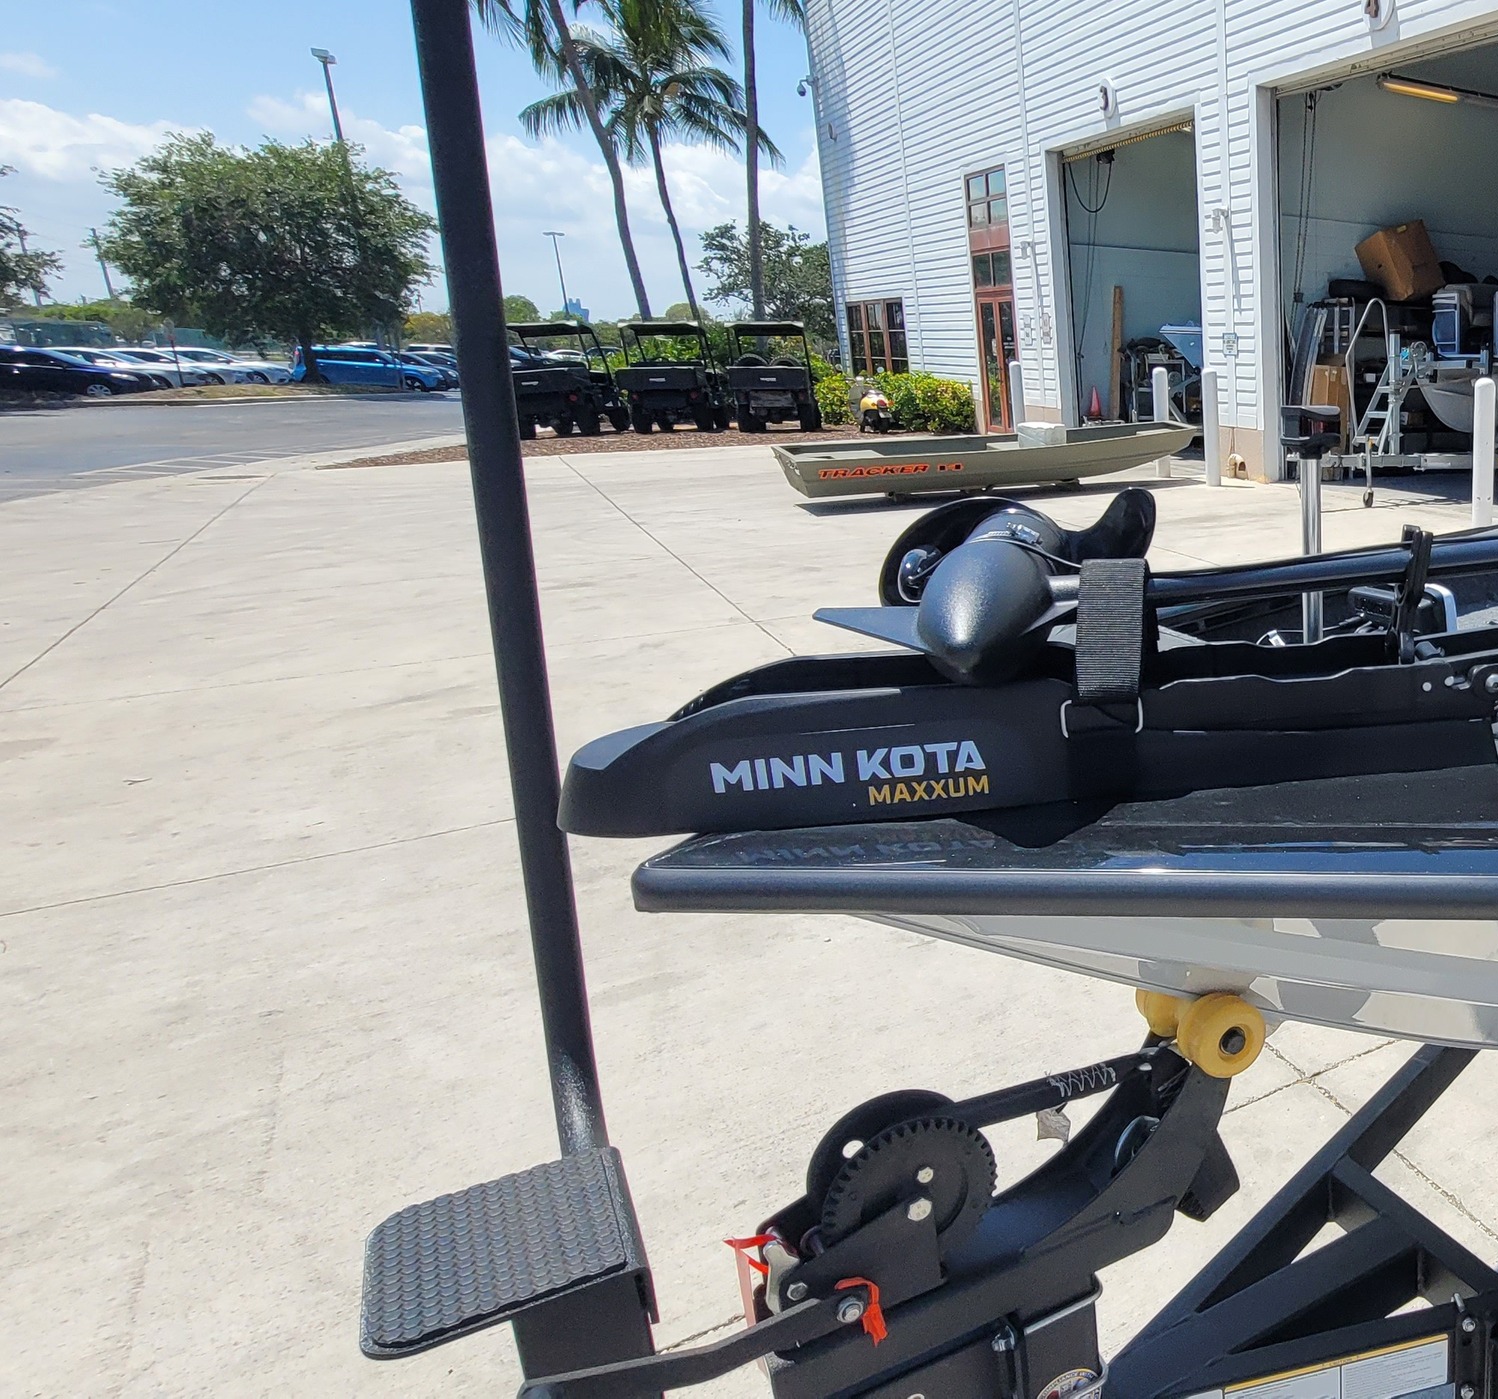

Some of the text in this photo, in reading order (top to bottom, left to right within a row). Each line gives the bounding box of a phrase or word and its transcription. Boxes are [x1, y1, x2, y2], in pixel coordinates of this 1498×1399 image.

[1100, 86, 1109, 111] 3
[818, 463, 930, 480] TRACKER
[709, 740, 987, 794] MINN KOTA
[868, 775, 990, 806] MAXXUM
